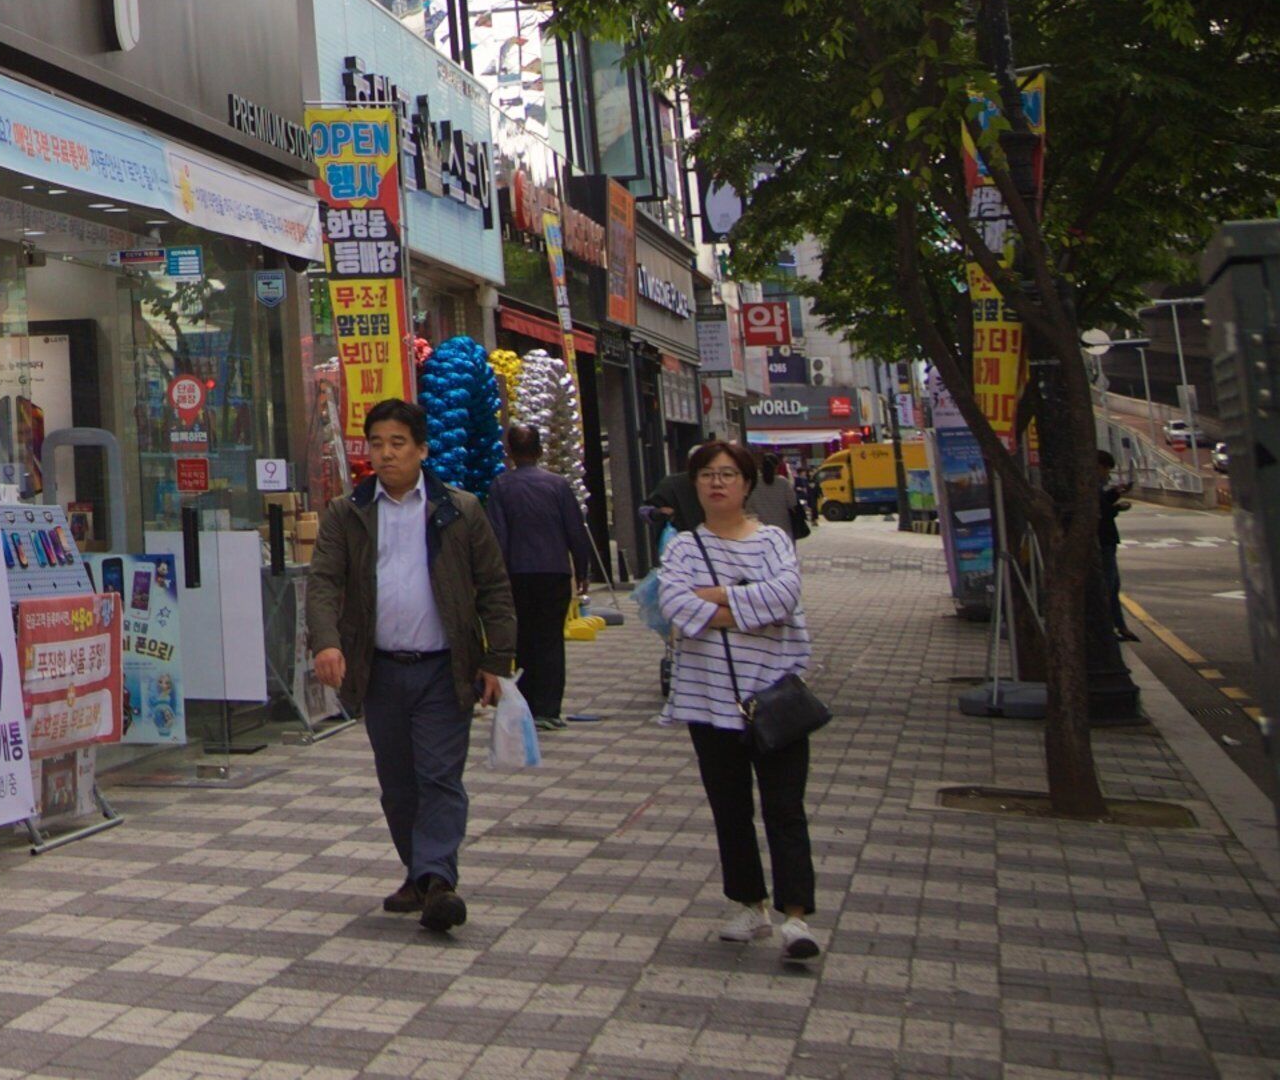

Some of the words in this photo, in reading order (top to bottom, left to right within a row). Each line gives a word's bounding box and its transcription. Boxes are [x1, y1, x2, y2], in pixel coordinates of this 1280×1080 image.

[230, 93, 286, 150] PREMIUM
[285, 120, 315, 163] STOR
[311, 122, 390, 158] OPEN
[326, 163, 383, 201] 행사
[326, 207, 387, 239] 화명동
[746, 305, 786, 343] 약
[343, 341, 374, 365] 보다
[749, 399, 801, 416] WORLD
